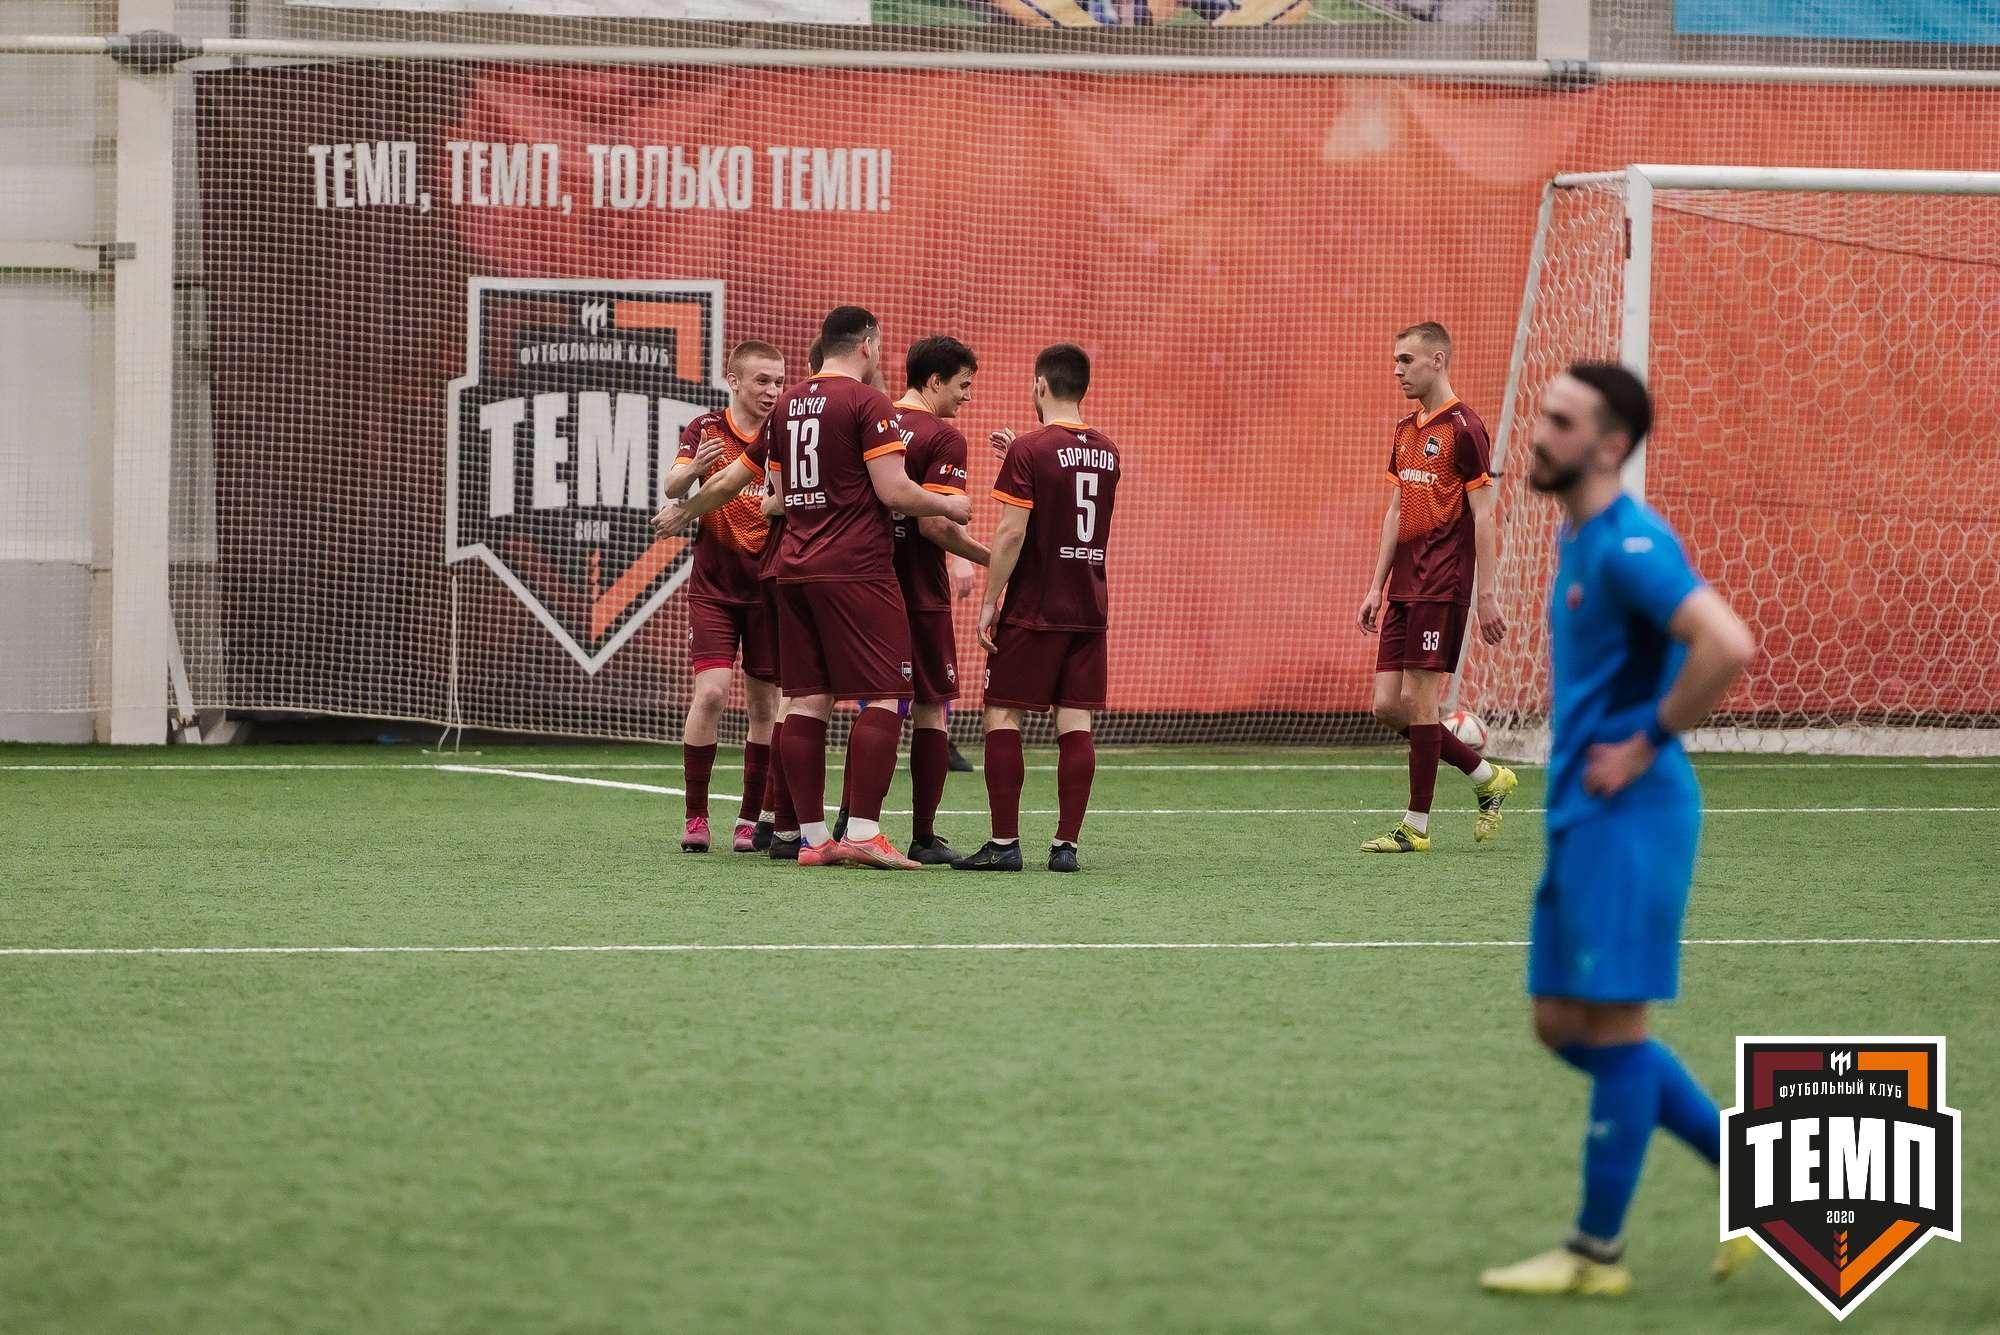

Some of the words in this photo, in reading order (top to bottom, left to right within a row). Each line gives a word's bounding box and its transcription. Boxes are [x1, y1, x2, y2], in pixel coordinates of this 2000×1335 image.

[308, 141, 432, 213] ТЕМП,
[446, 141, 572, 216] ТЕМП,
[587, 144, 753, 210] ТОЛЬКО
[767, 146, 892, 211] ТЕМП!
[520, 340, 622, 365] ФУТБОЛЬНЫЙ
[628, 343, 670, 367] КЛУБ
[789, 397, 827, 417] СЫЧЕВ
[787, 418, 820, 489] 13
[1057, 447, 1115, 471] БОРИСОВ
[785, 492, 826, 507] SEUS
[1076, 471, 1098, 543] 5
[575, 520, 610, 541] 2020
[1423, 631, 1440, 651] 33
